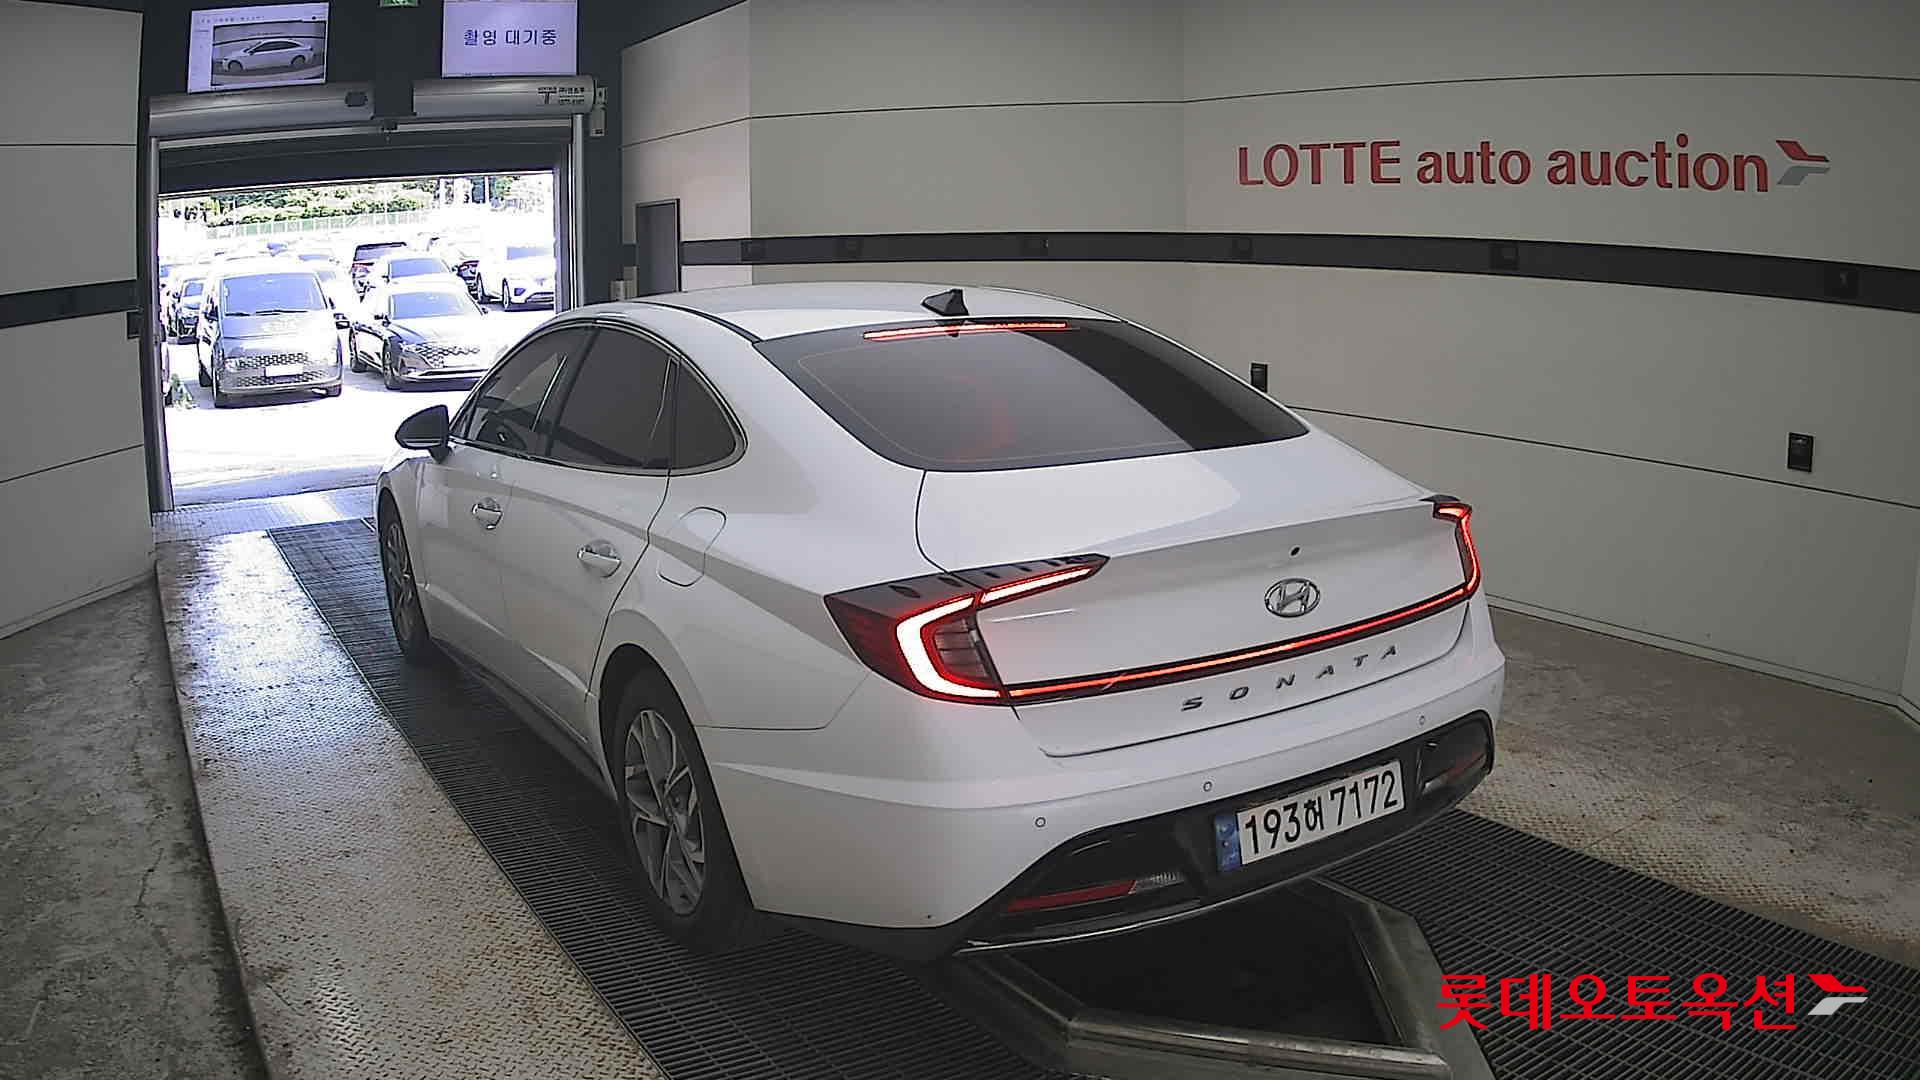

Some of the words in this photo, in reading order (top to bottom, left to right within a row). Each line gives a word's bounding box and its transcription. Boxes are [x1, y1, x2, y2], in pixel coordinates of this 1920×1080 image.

[505, 29, 557, 46] 대기중
[1239, 140, 1401, 187] LOTTE
[1417, 141, 1531, 187] auto
[1548, 133, 1769, 193] auction
[1181, 645, 1398, 712] SONATA
